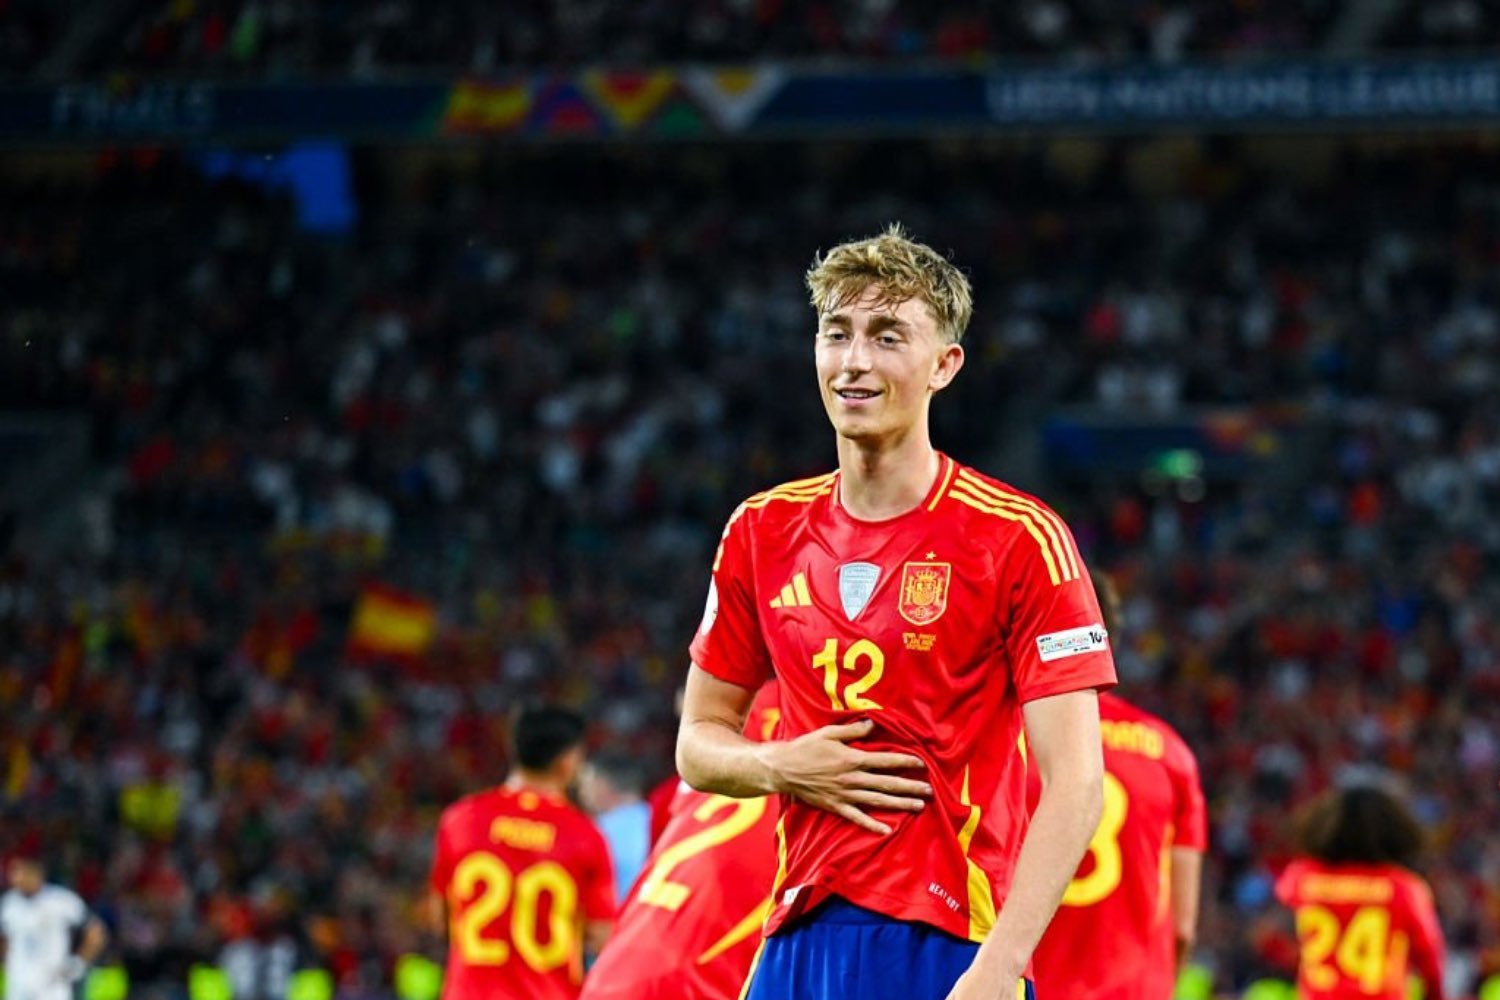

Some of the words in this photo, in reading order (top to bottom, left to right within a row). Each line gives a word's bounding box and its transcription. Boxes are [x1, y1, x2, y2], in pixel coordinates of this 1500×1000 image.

[812, 638, 885, 711] 12
[636, 793, 768, 912] 2
[451, 850, 578, 974] 20
[1295, 904, 1392, 995] 24
